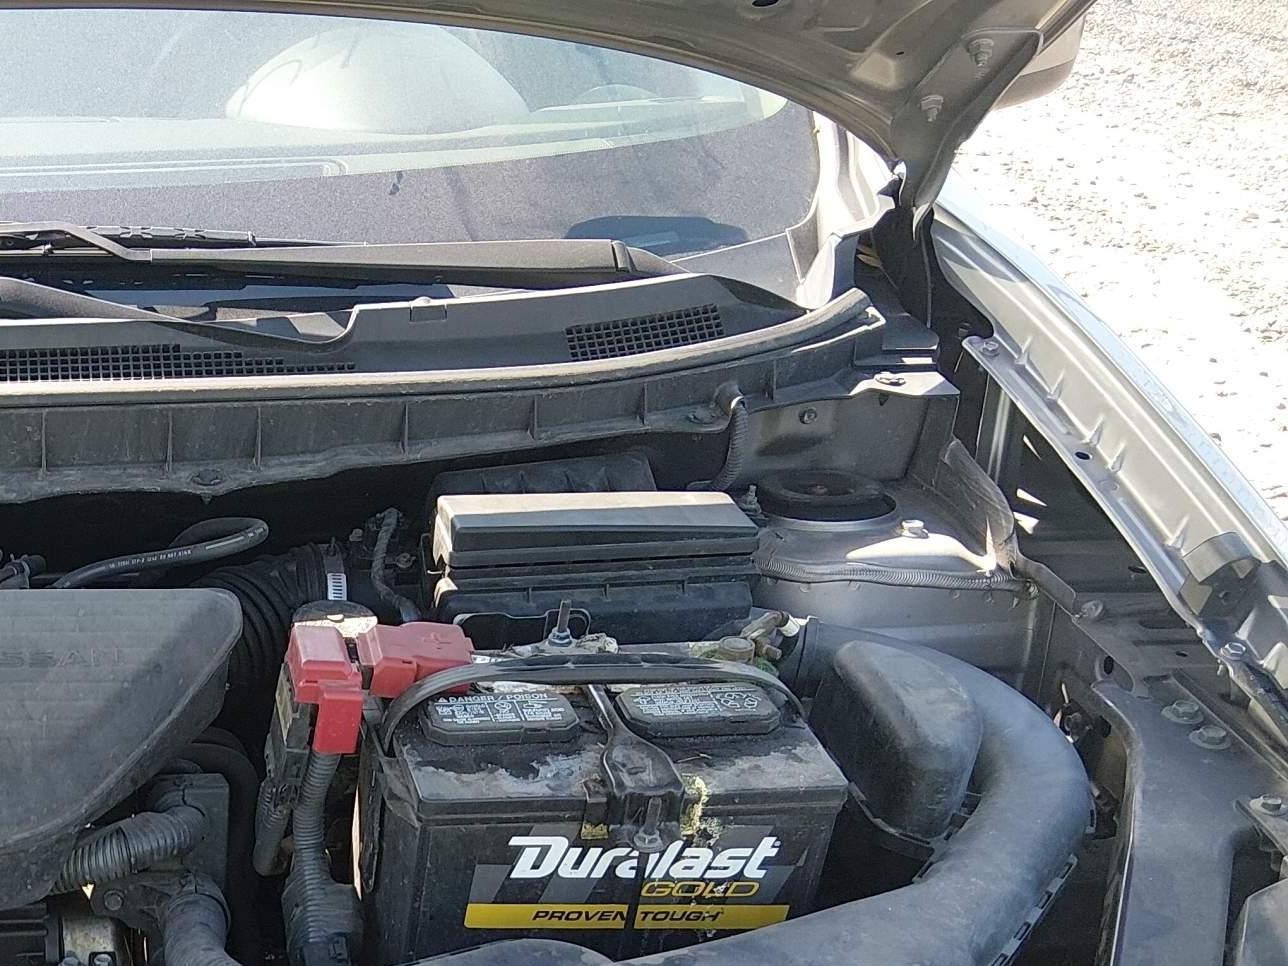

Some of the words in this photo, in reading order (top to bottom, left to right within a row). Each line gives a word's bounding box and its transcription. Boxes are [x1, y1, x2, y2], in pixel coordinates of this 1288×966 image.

[505, 693, 549, 701] POISON
[508, 836, 777, 879] Duralast
[641, 881, 760, 898] GOLD
[531, 910, 626, 922] PROVEN
[639, 910, 720, 922] TOUGH
